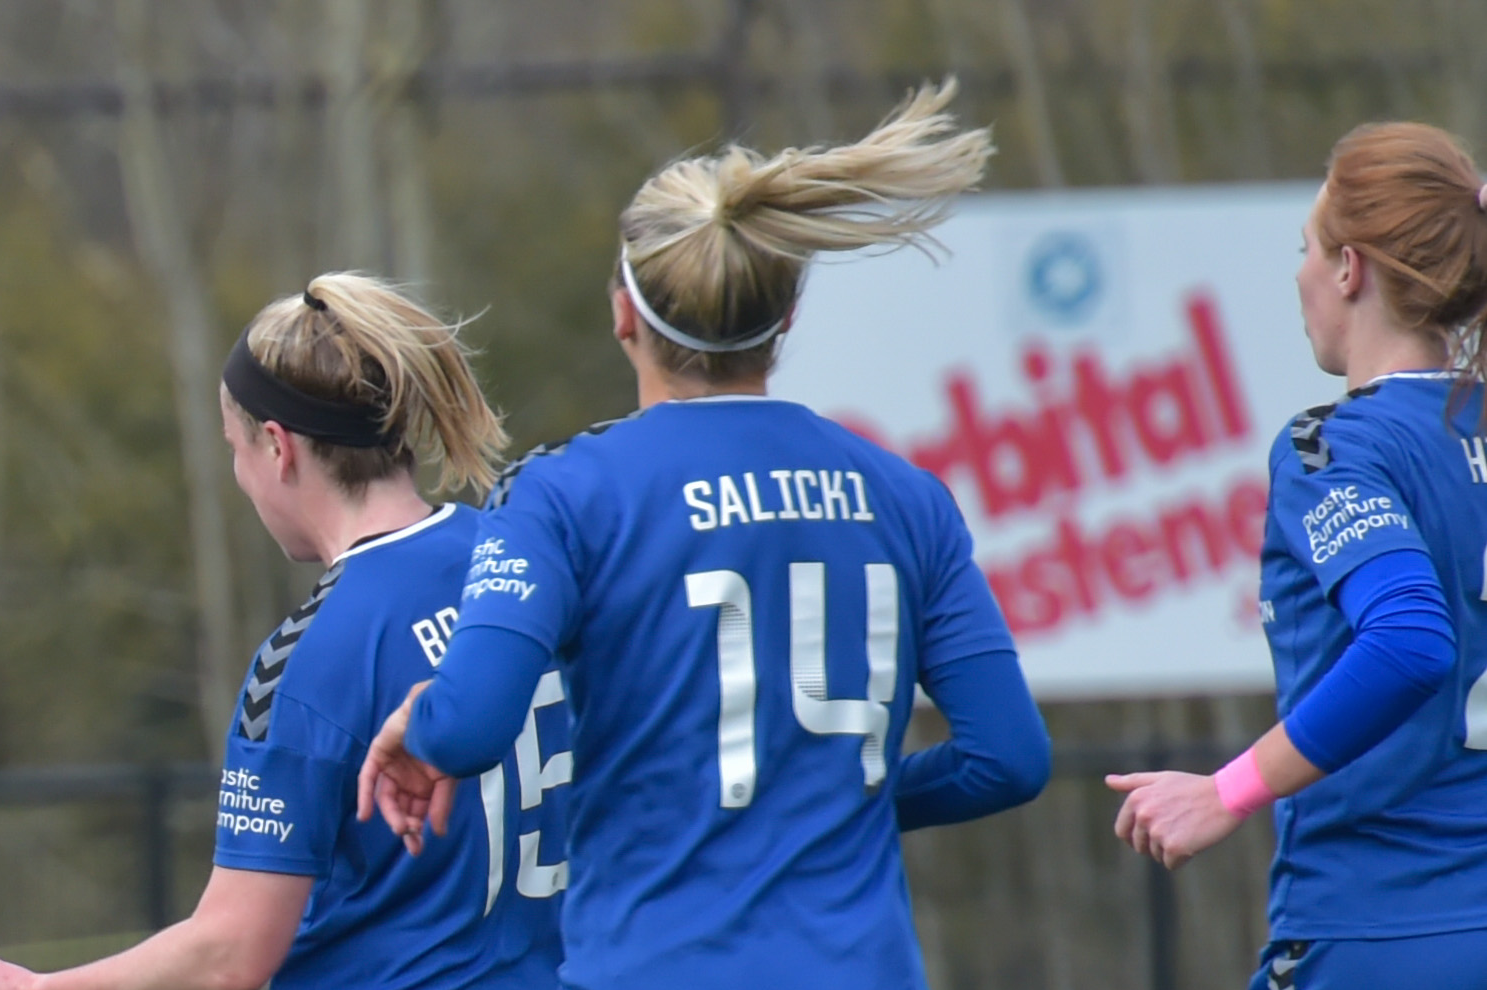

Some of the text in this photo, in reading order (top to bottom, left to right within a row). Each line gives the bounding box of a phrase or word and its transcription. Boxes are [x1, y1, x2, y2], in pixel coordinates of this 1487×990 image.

[822, 287, 1251, 520] rbital
[1302, 485, 1359, 535] Plastic
[1309, 496, 1392, 551] Furniture
[1312, 513, 1408, 564] Company
[684, 561, 898, 809] 14
